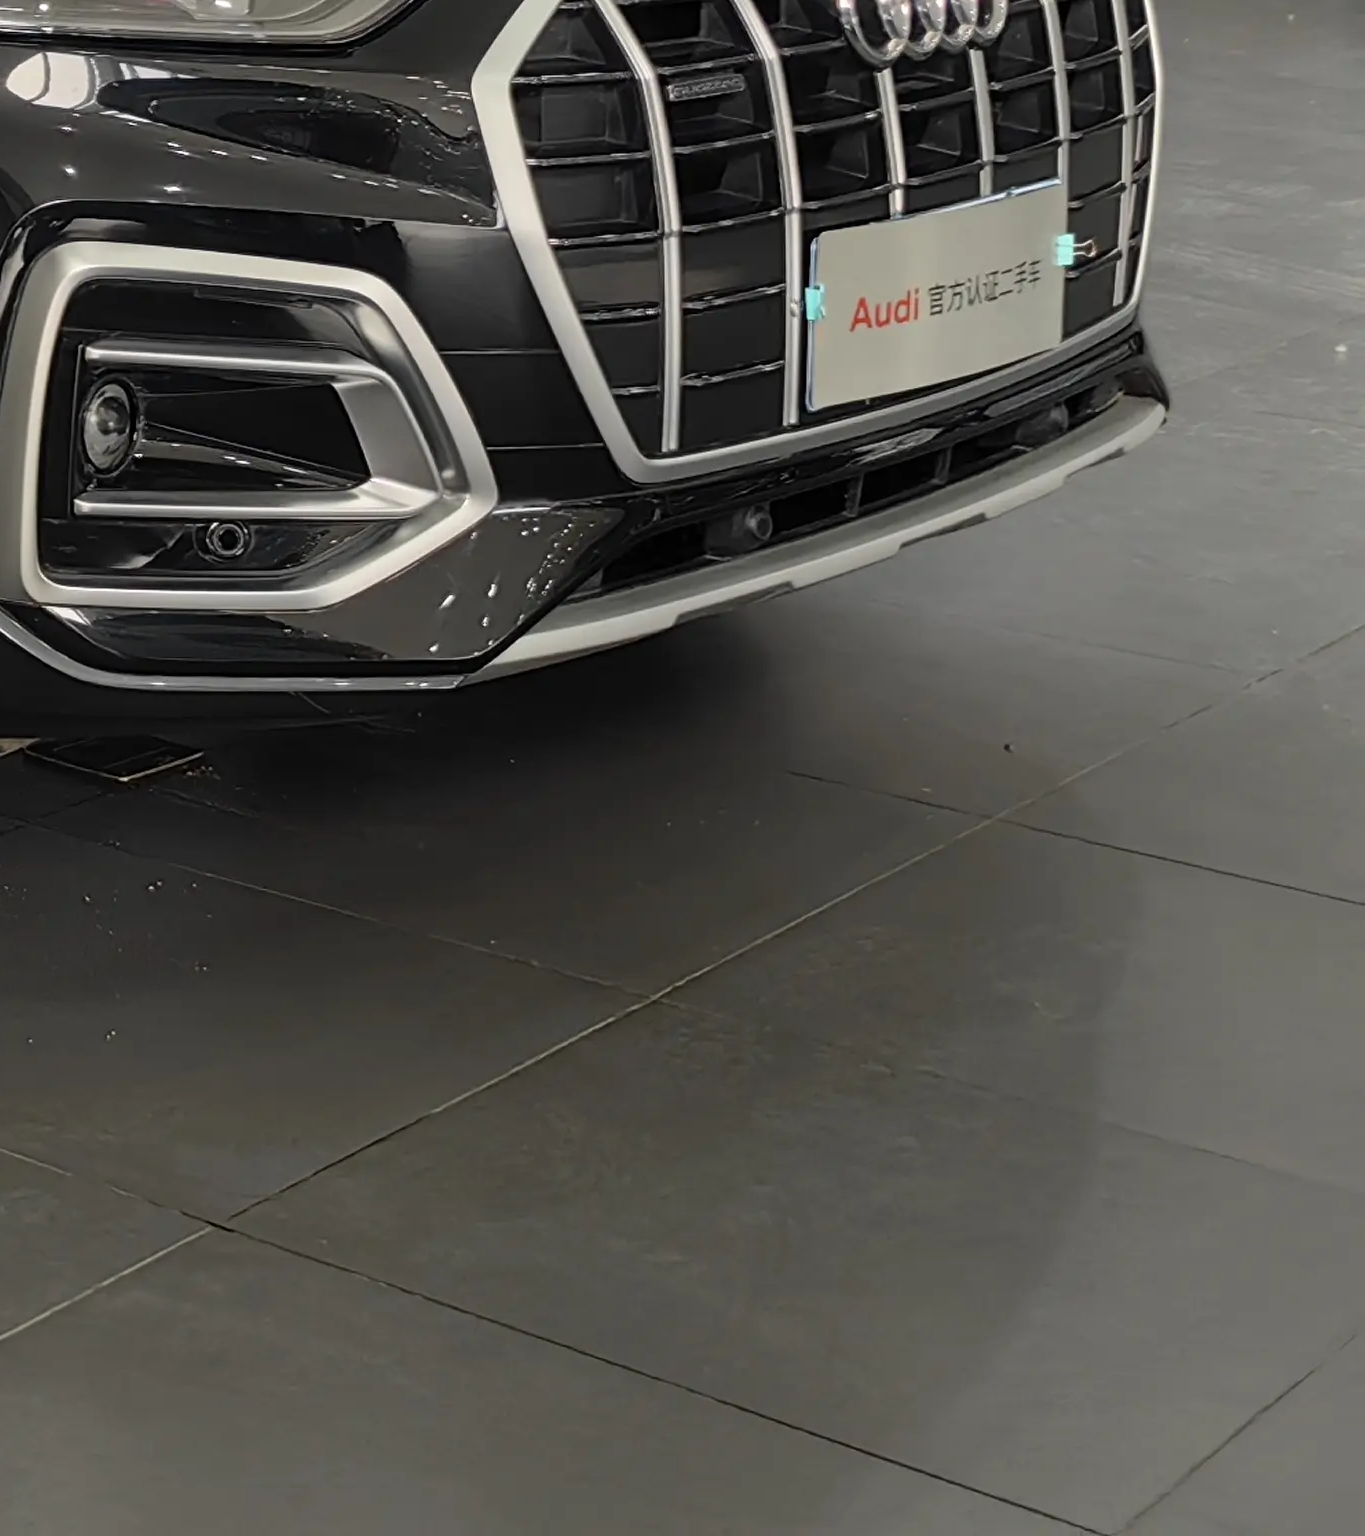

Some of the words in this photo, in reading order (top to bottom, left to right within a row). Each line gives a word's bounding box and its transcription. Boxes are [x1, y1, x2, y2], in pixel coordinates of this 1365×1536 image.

[849, 289, 920, 332] Audi
[927, 260, 1042, 317] 官方认证二手车
